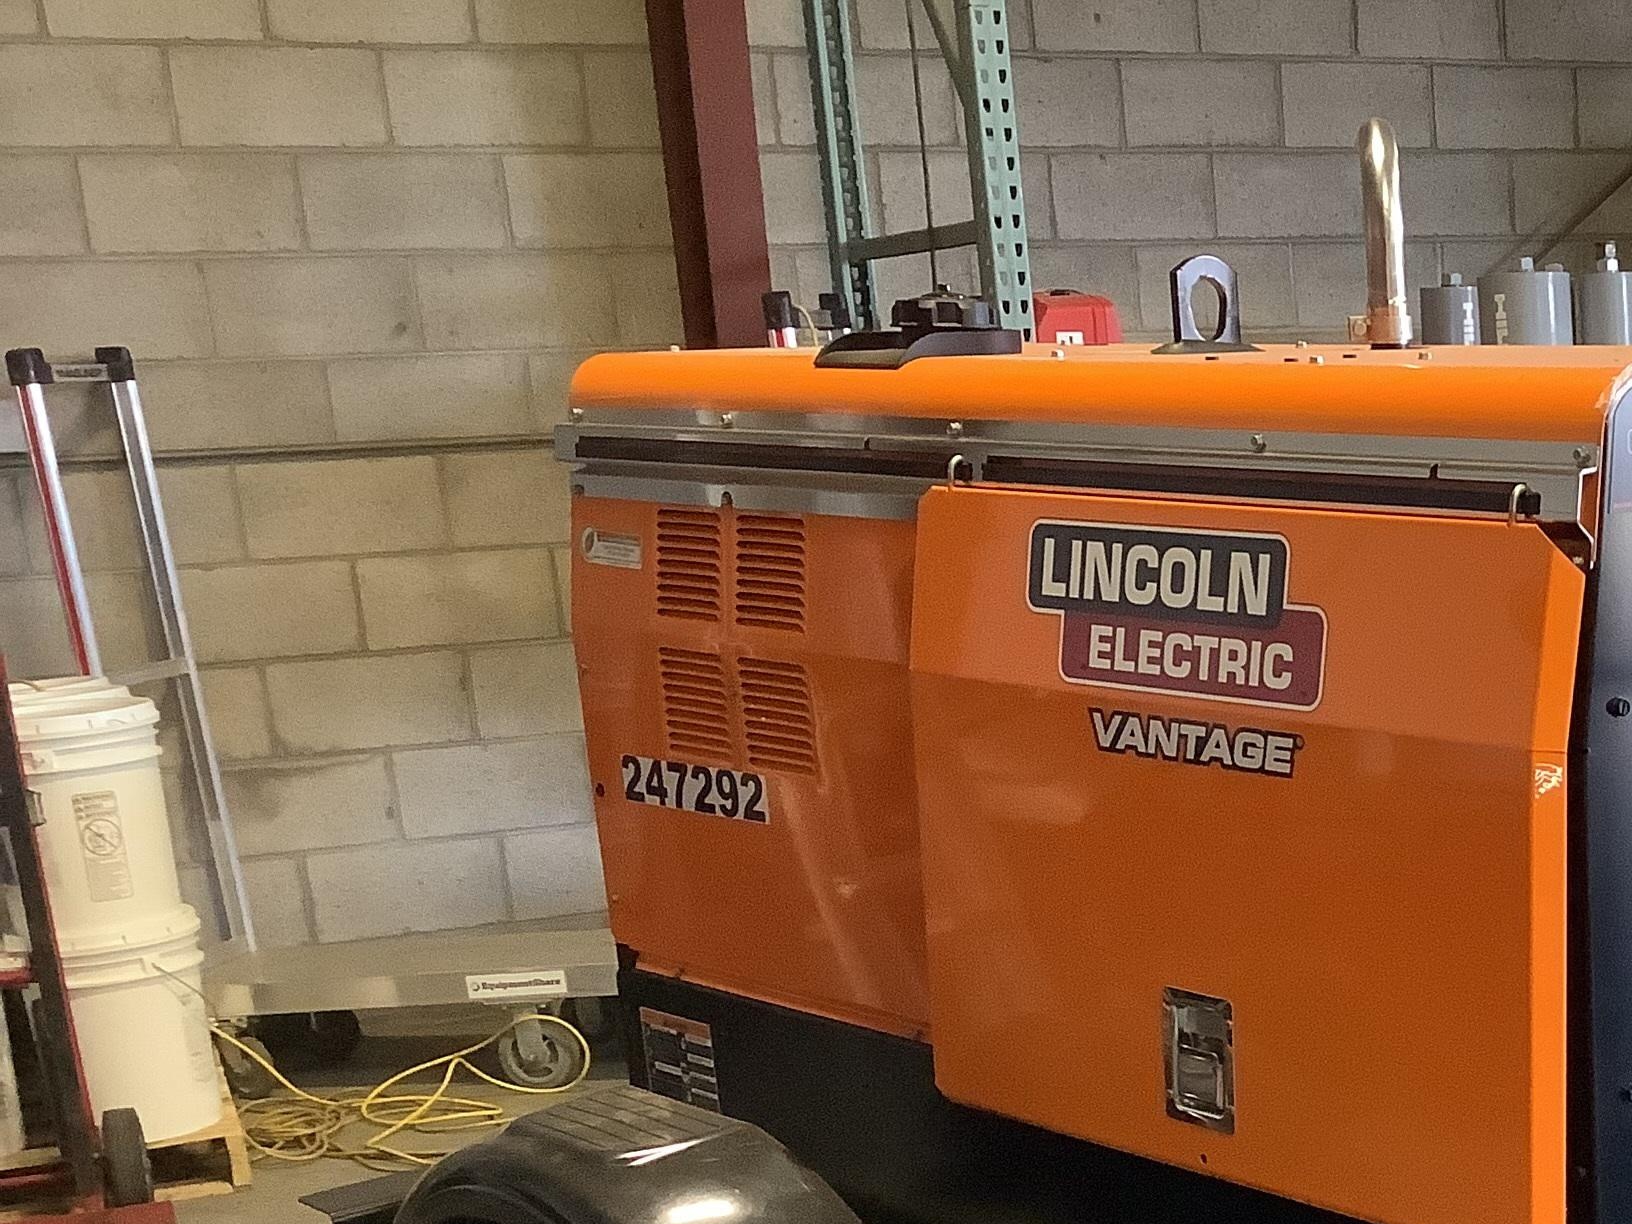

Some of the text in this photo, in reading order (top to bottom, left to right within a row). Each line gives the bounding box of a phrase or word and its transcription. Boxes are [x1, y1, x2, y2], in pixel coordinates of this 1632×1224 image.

[1041, 537, 1271, 617] LINCOLN
[1088, 624, 1294, 691] ELECTRIC
[1091, 711, 1294, 774] VANTAGE
[621, 754, 767, 823] 247292
